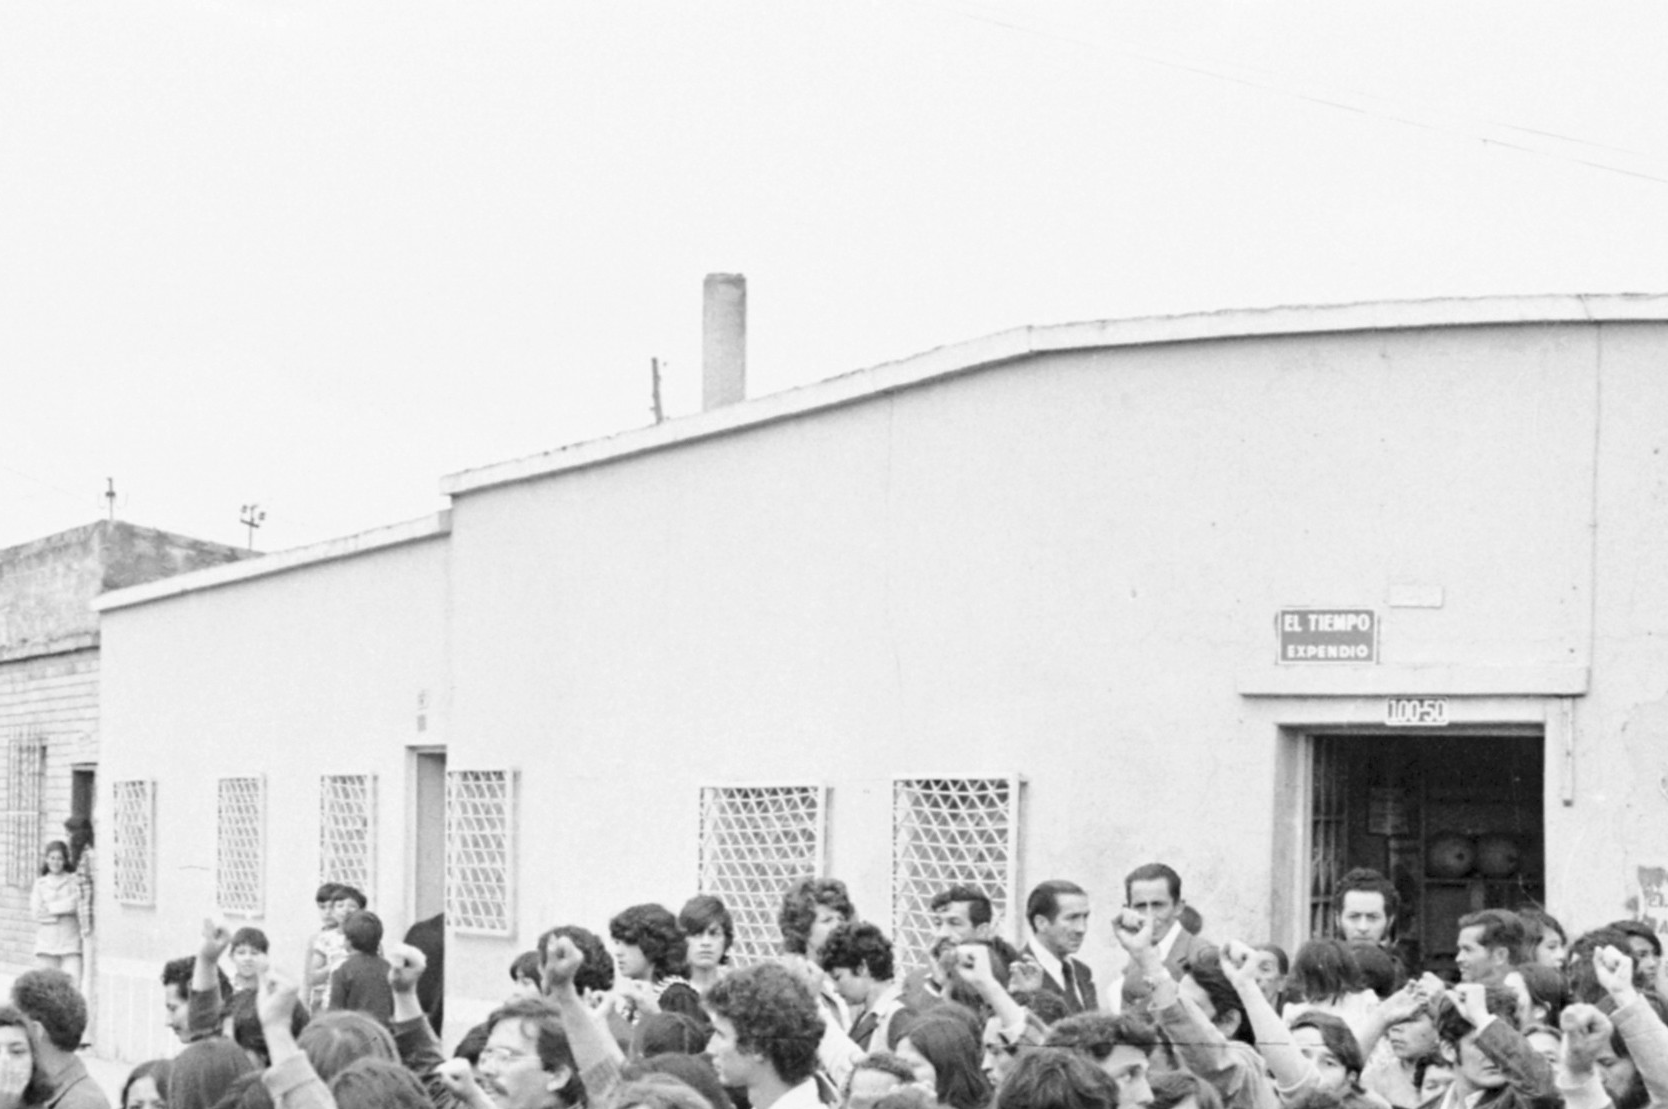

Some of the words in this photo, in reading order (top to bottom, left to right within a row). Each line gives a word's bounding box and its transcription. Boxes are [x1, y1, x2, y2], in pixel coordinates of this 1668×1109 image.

[1283, 613, 1303, 632] EL
[1308, 613, 1370, 632] TIEMPO
[1287, 644, 1368, 659] EXPENDIO
